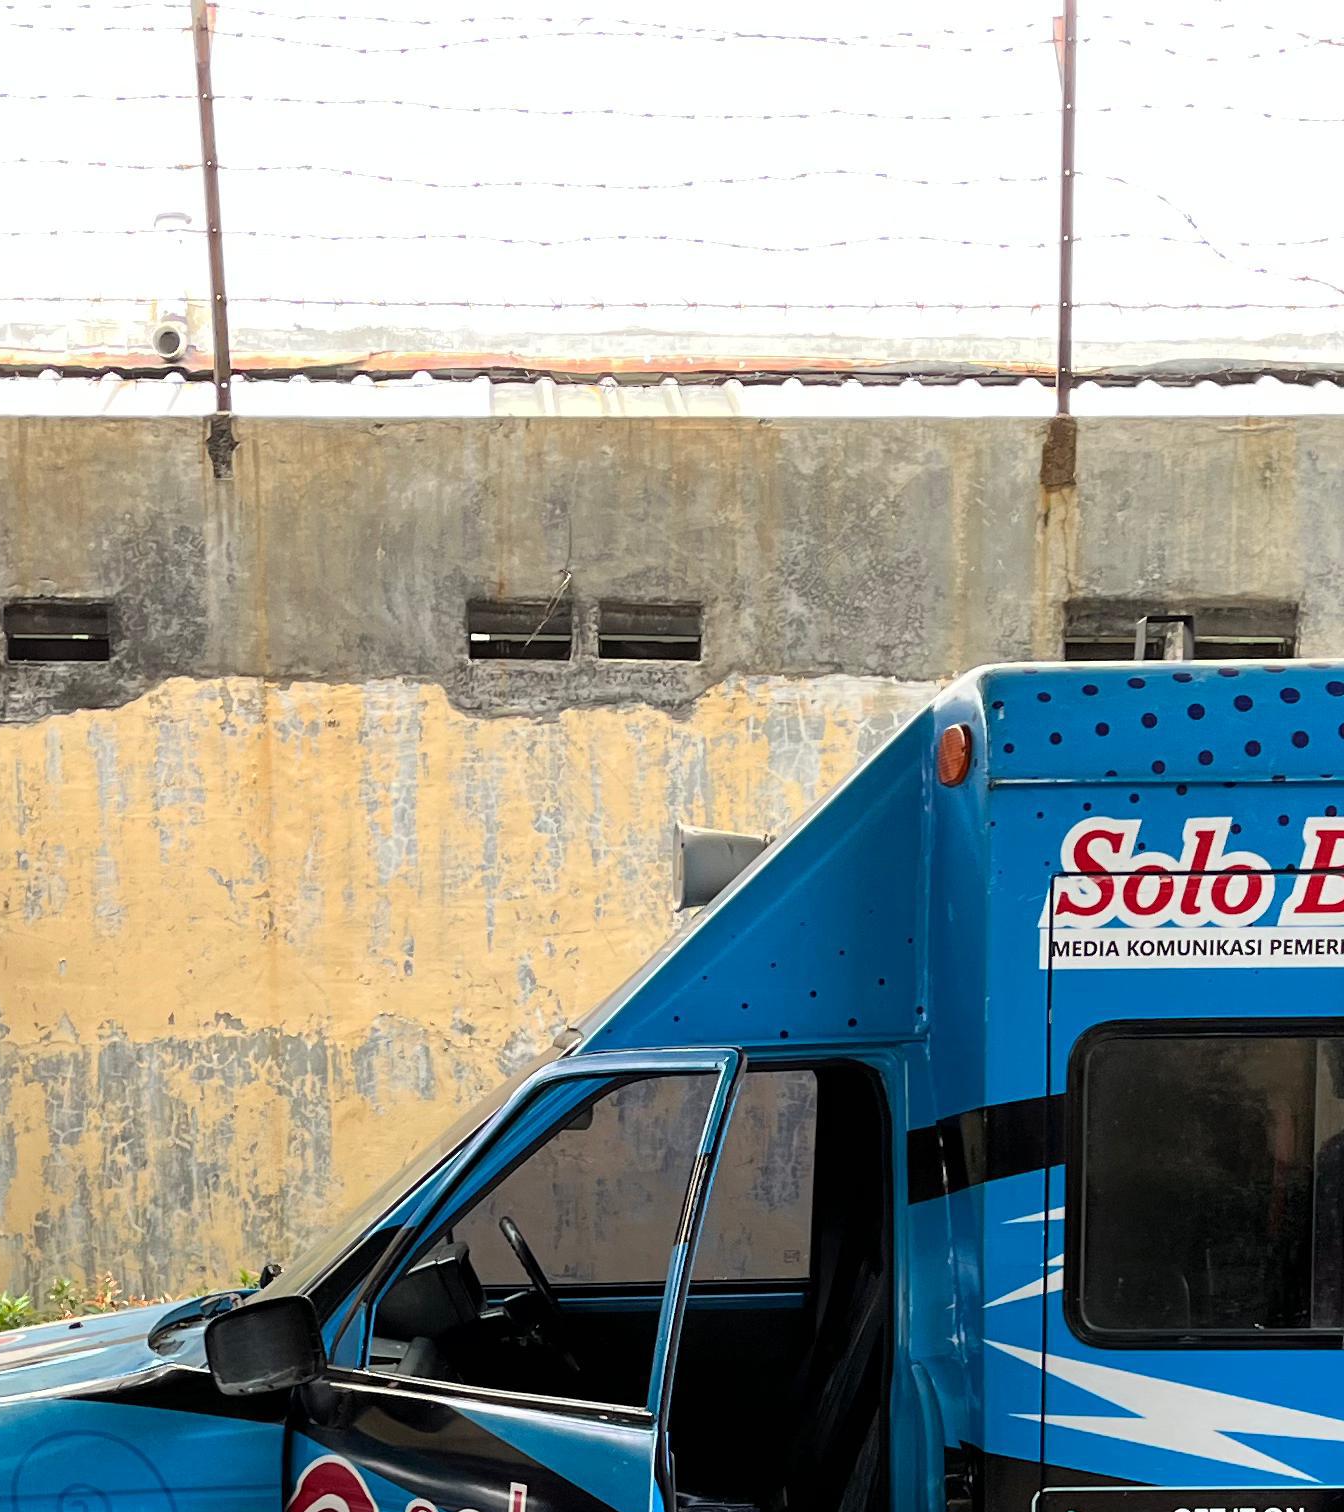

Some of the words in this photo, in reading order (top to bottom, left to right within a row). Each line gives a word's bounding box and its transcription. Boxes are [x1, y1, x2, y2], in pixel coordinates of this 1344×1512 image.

[1055, 828, 1263, 916] Solo
[1052, 939, 1120, 957] MEDIA
[1127, 938, 1262, 957] KOMUNIKASI
